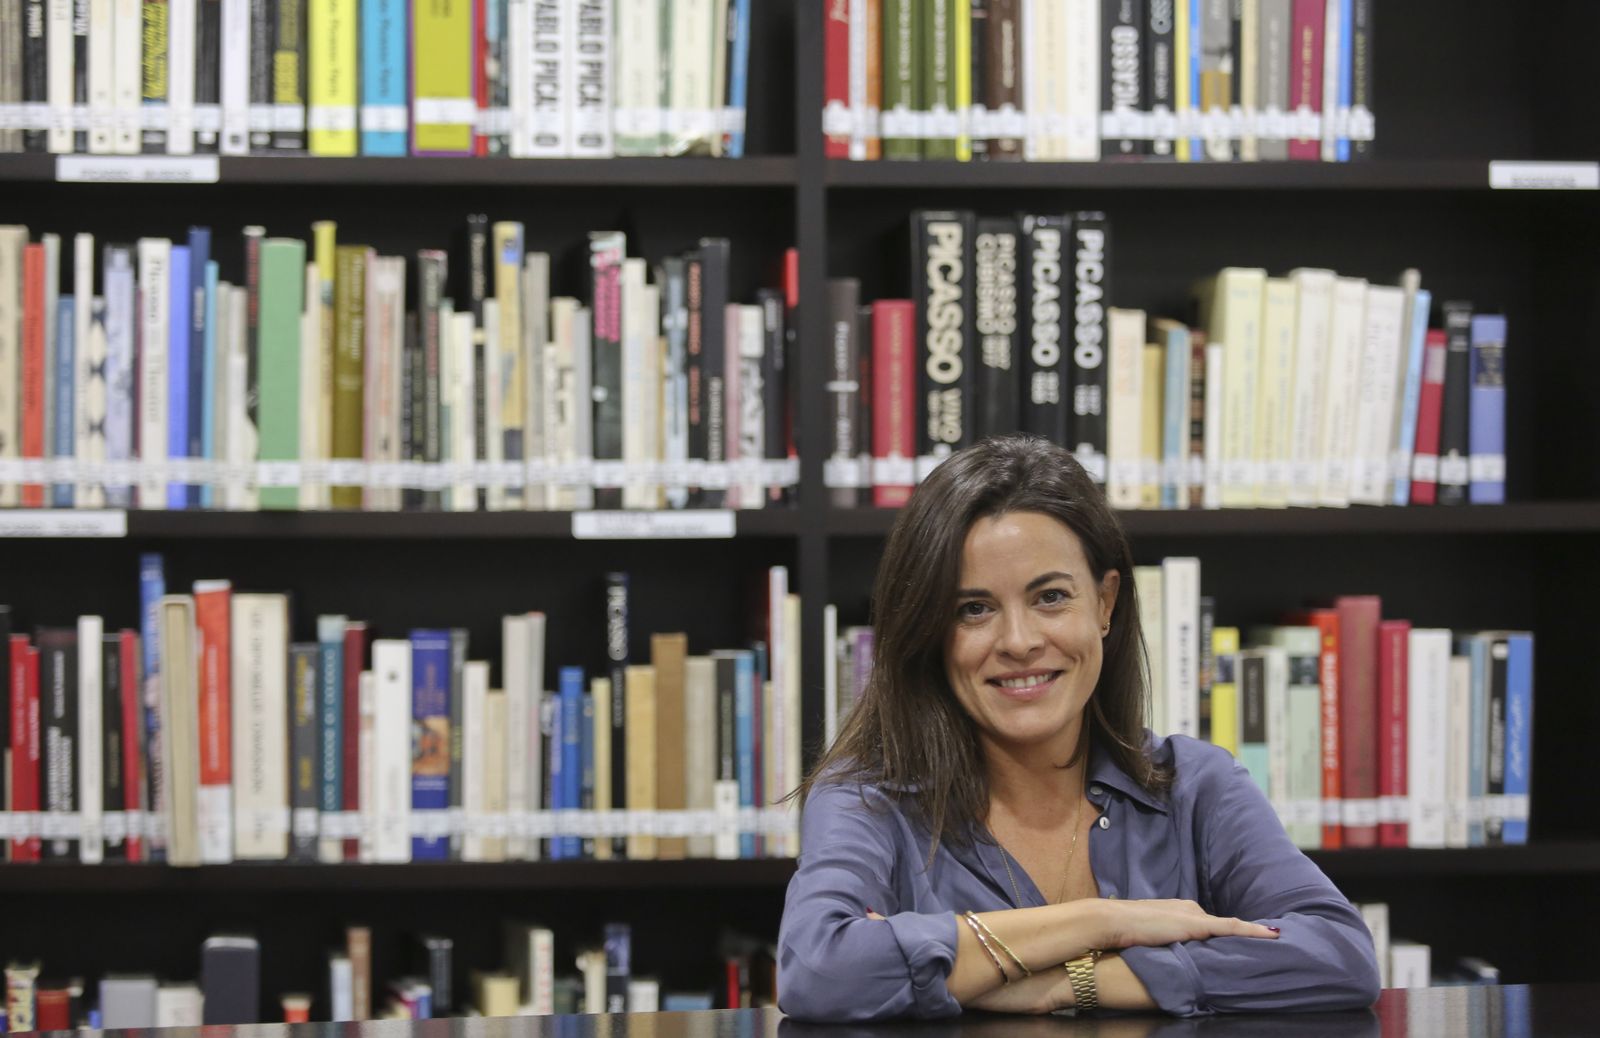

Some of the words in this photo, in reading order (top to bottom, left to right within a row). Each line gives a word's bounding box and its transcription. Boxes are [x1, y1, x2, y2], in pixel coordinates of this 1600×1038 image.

[534, 0, 561, 53] ABLO
[926, 222, 964, 383] PICASSO
[996, 233, 1017, 335] PICASSO
[1031, 229, 1061, 366] PICASSO
[1074, 229, 1105, 369] PICASSO
